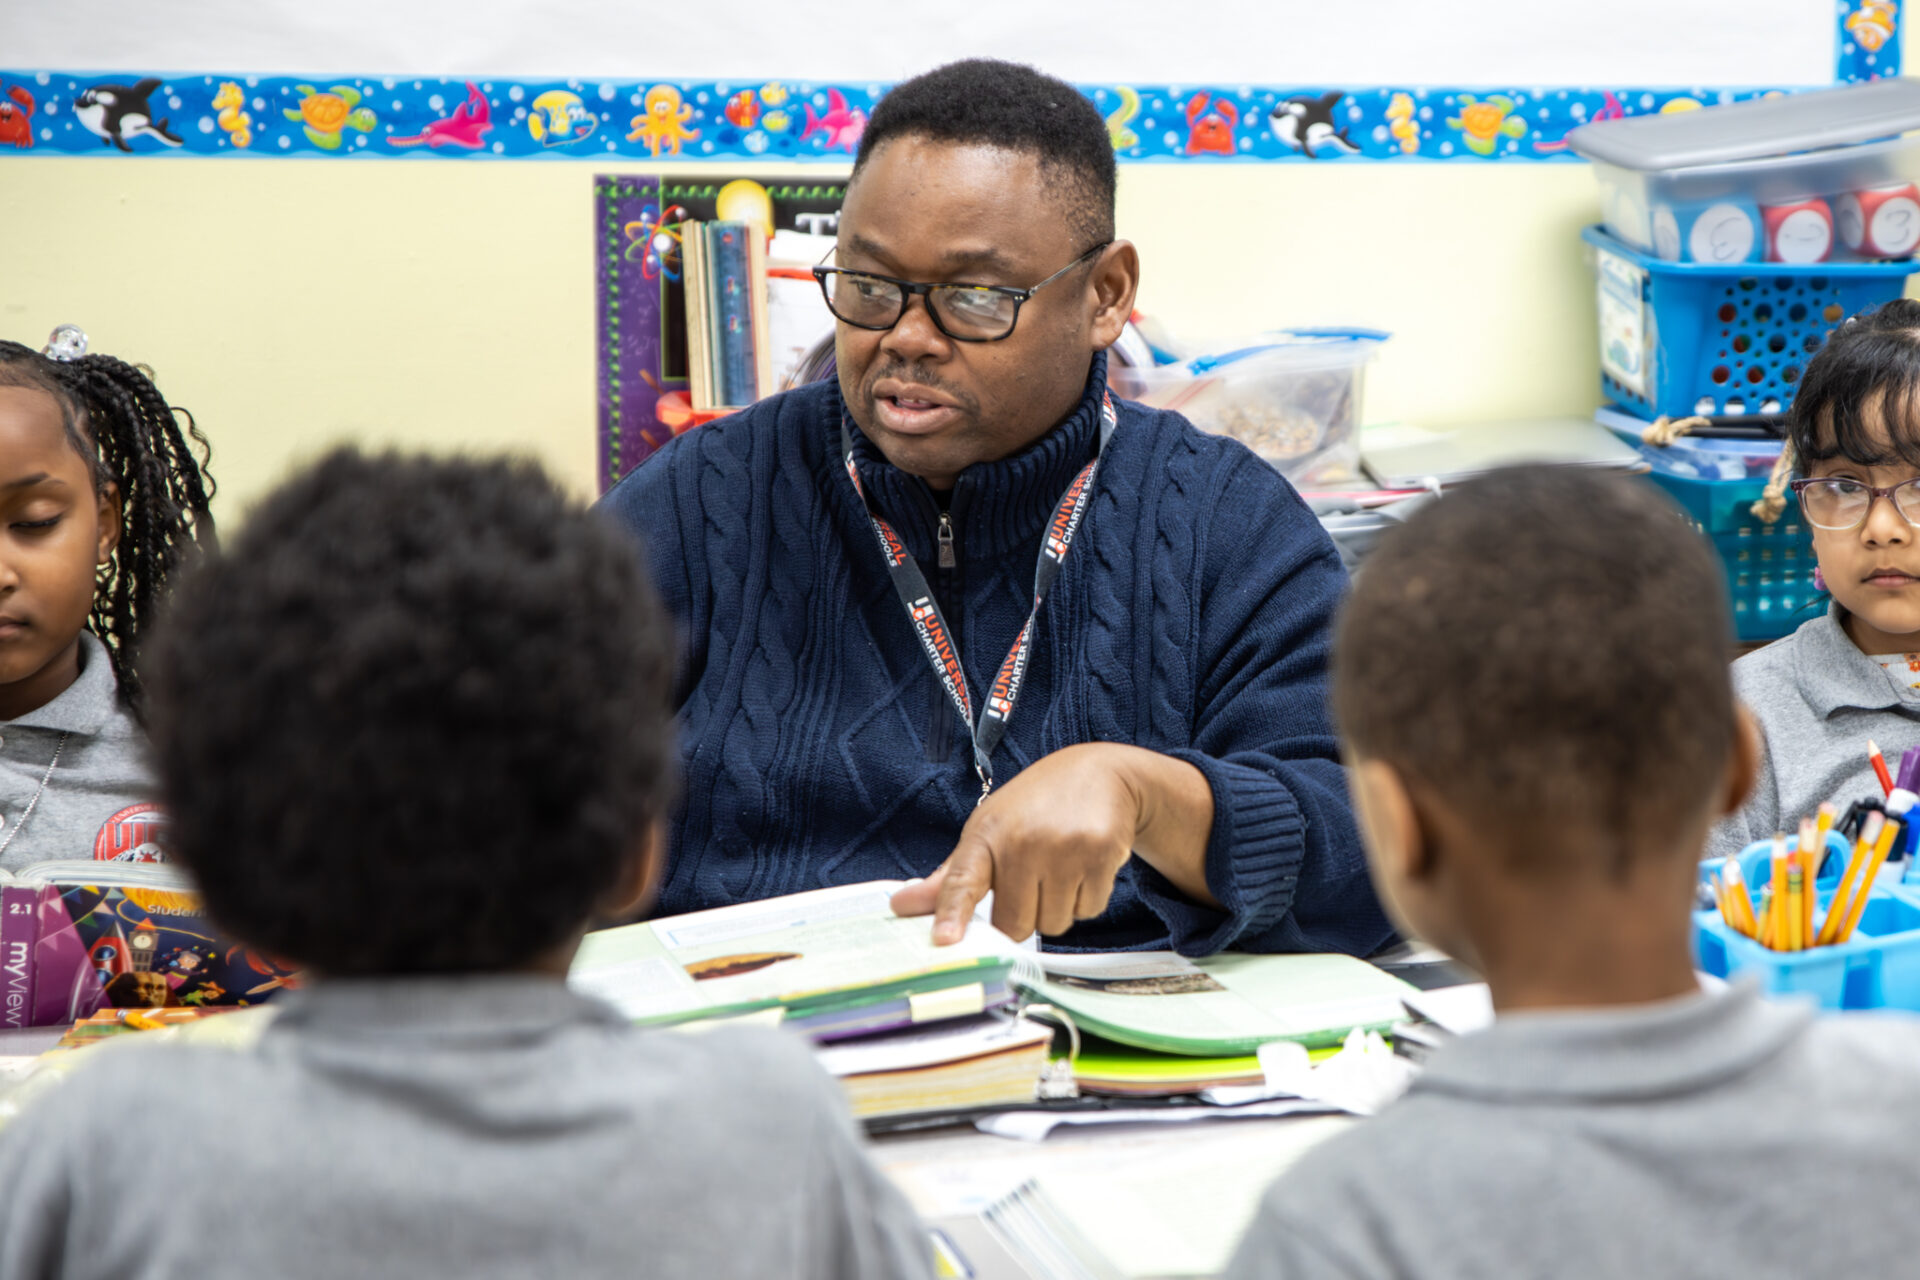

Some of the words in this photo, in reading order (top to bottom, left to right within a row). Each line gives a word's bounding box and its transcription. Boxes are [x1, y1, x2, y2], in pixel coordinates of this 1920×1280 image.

[1062, 492, 1088, 544] CHARTER
[915, 620, 947, 675] CHARTER
[1006, 645, 1027, 700] CHARTER
[9, 903, 32, 915] 2.1
[3, 942, 28, 1026] myView
